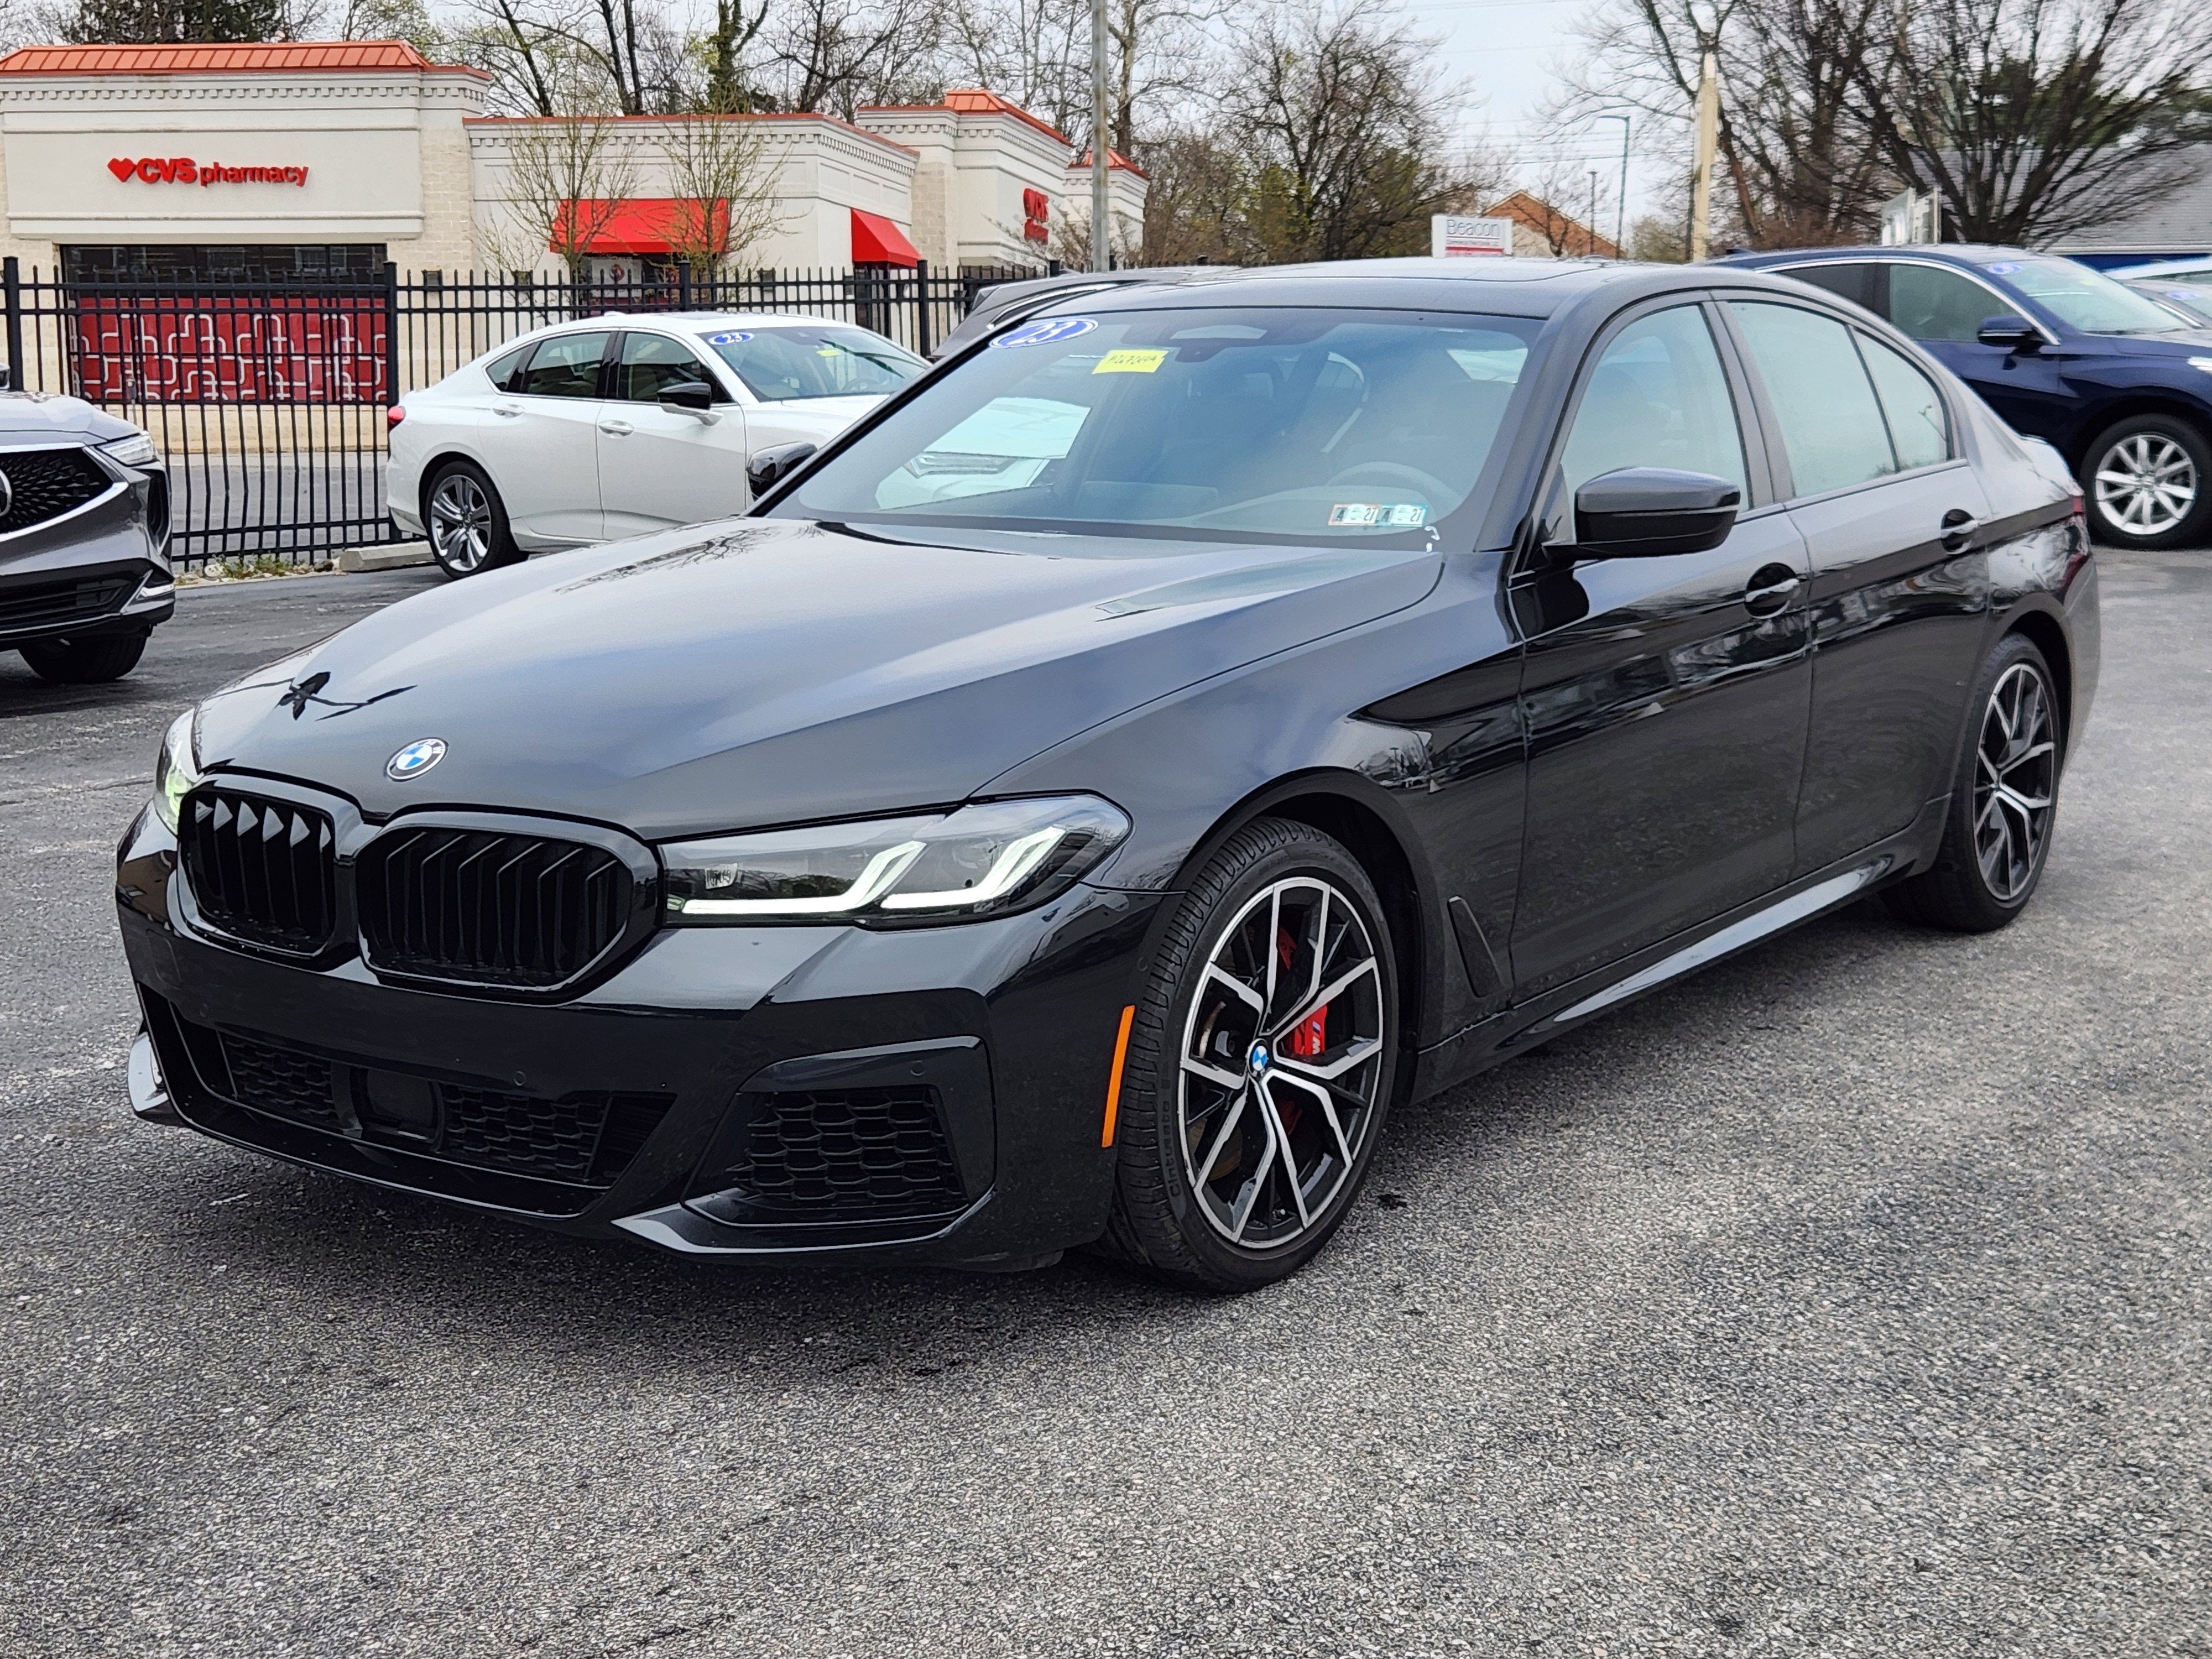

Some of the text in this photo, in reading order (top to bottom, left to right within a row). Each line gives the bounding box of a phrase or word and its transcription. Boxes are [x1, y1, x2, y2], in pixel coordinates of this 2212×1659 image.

[136, 158, 309, 187] CVS pharmacy
[1446, 219, 1500, 236] Beacon
[722, 332, 743, 343] 23
